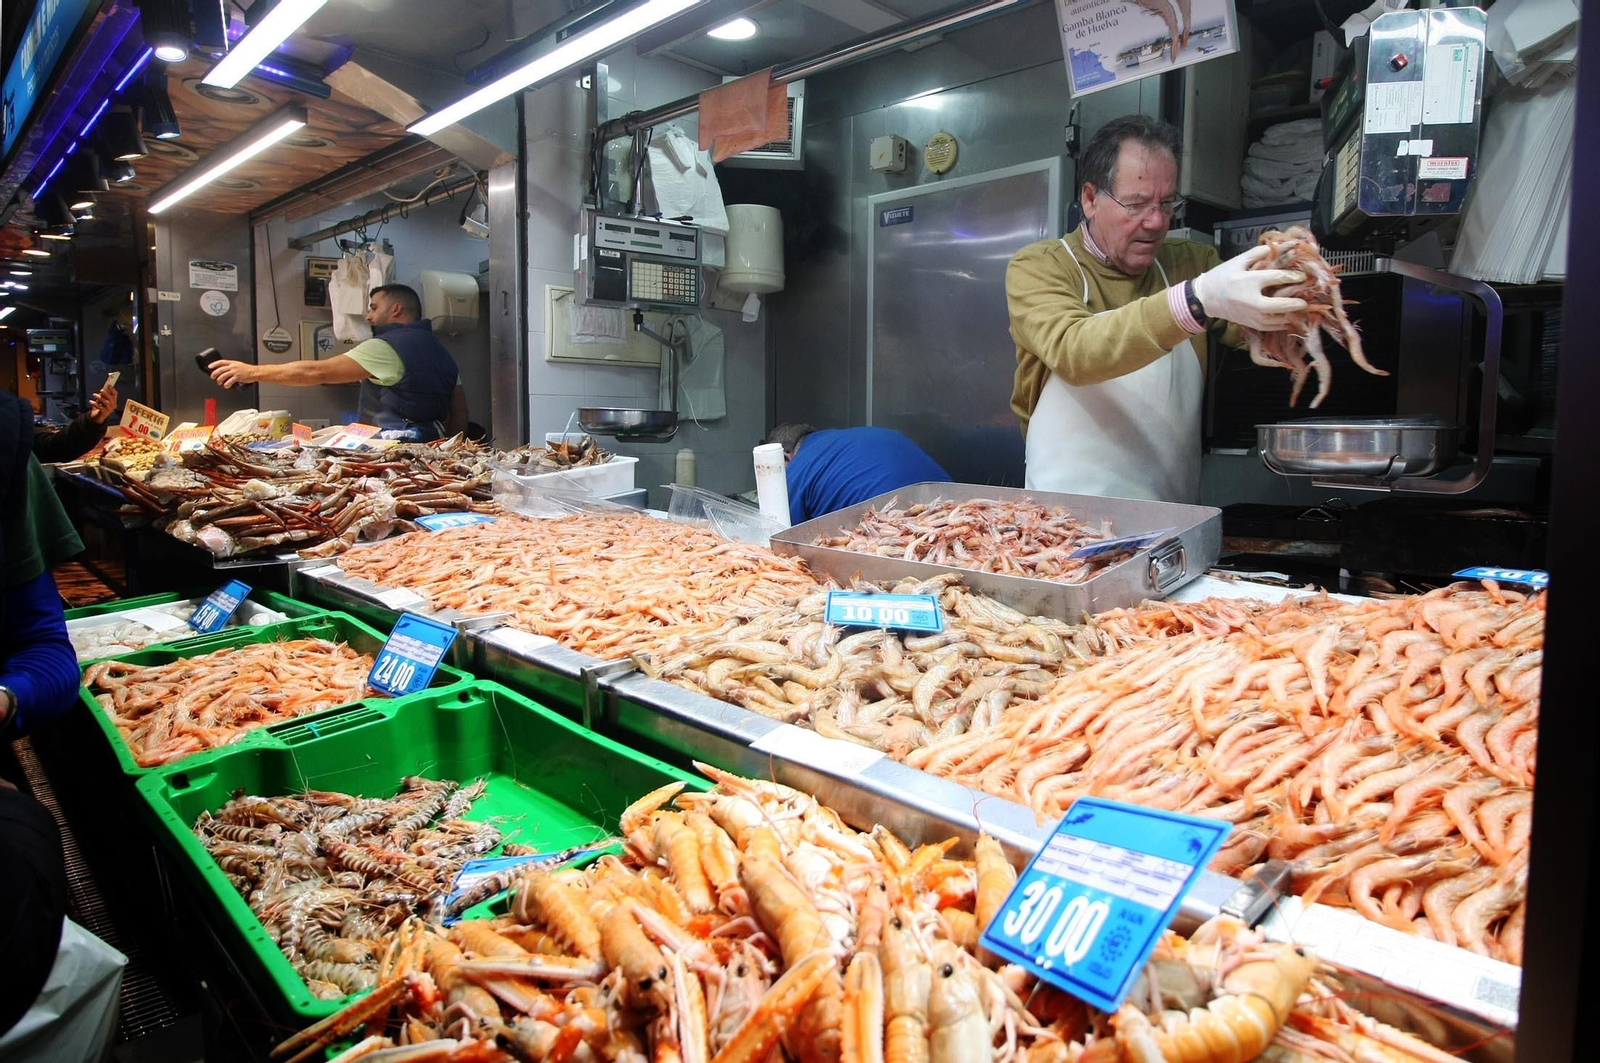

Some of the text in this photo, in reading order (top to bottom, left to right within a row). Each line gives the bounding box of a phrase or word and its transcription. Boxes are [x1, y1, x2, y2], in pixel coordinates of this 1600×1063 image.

[1062, 5, 1127, 33] Gamba Blanca
[1075, 19, 1119, 39] de Huelva
[129, 404, 164, 426] OFERTA
